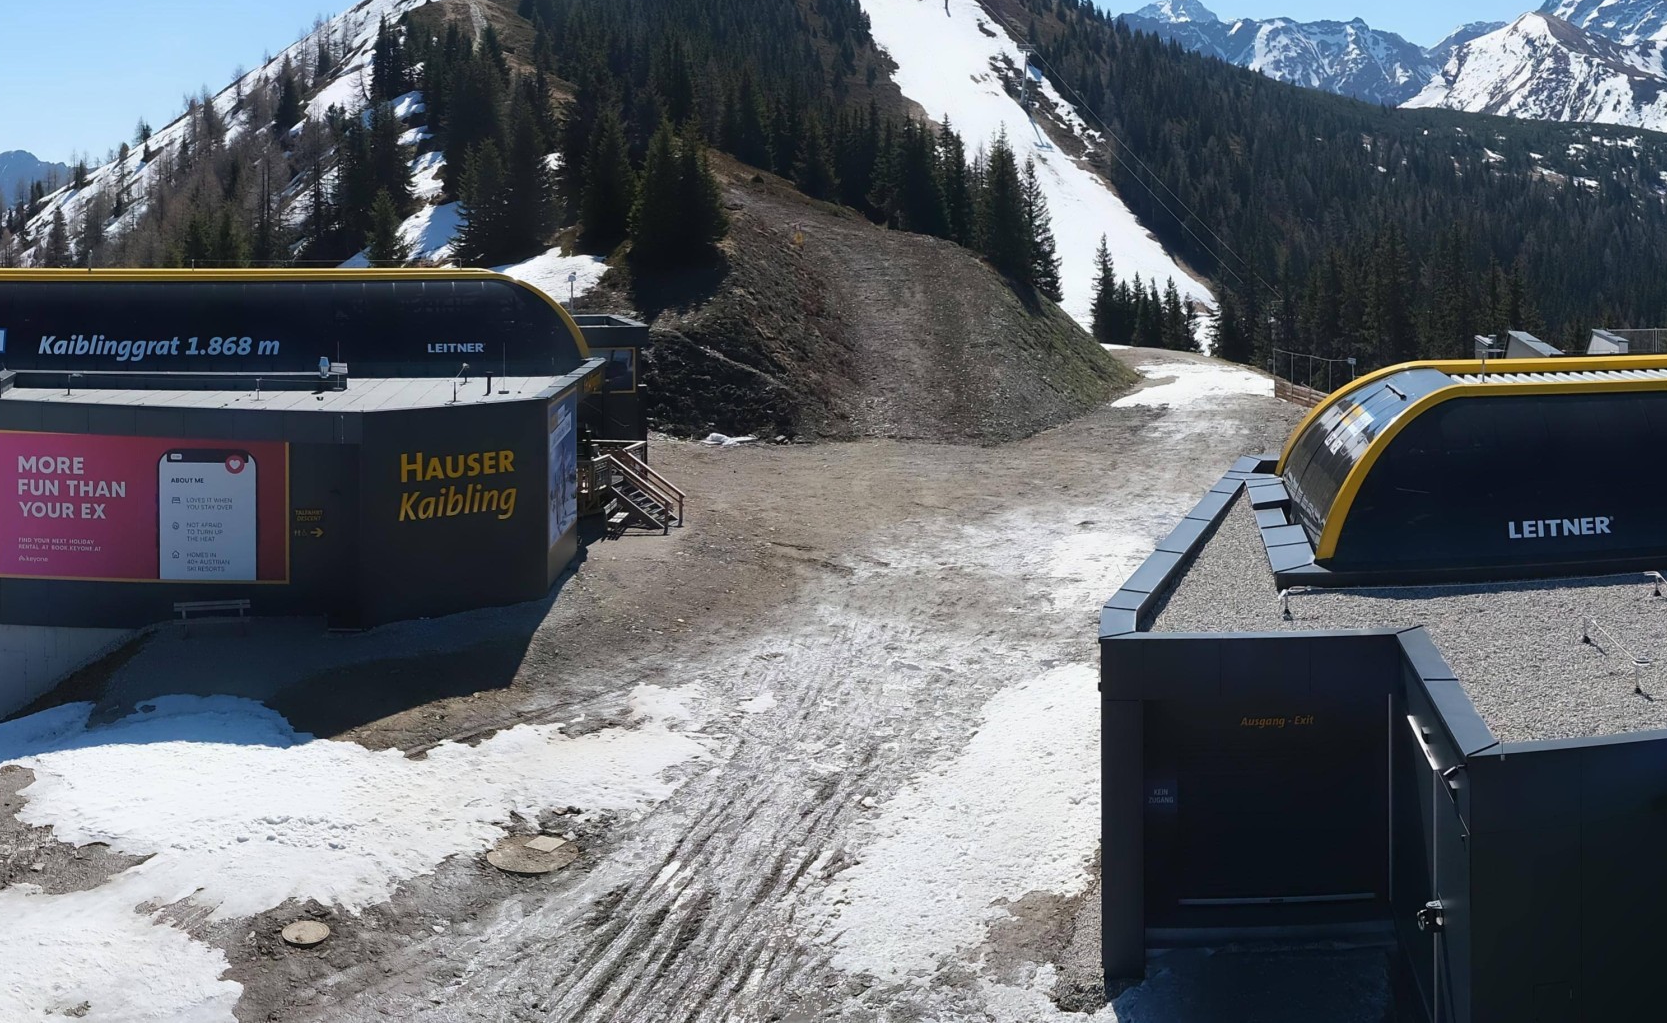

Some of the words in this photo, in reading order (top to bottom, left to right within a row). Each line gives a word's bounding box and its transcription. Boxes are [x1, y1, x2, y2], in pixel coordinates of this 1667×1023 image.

[38, 335, 180, 361] Kaiblinggrat
[185, 336, 252, 356] 1.868
[257, 339, 280, 356] m
[18, 456, 84, 474] MORE
[400, 450, 515, 483] HAUSER
[18, 479, 59, 496] FUN
[66, 480, 126, 497] THAN
[19, 502, 74, 518] YOUR
[81, 503, 106, 519] EX
[399, 484, 517, 522] Kaibling
[1240, 717, 1286, 728] Ausgang
[1294, 715, 1314, 725] Exit
[1148, 796, 1174, 804] ZUGANG
